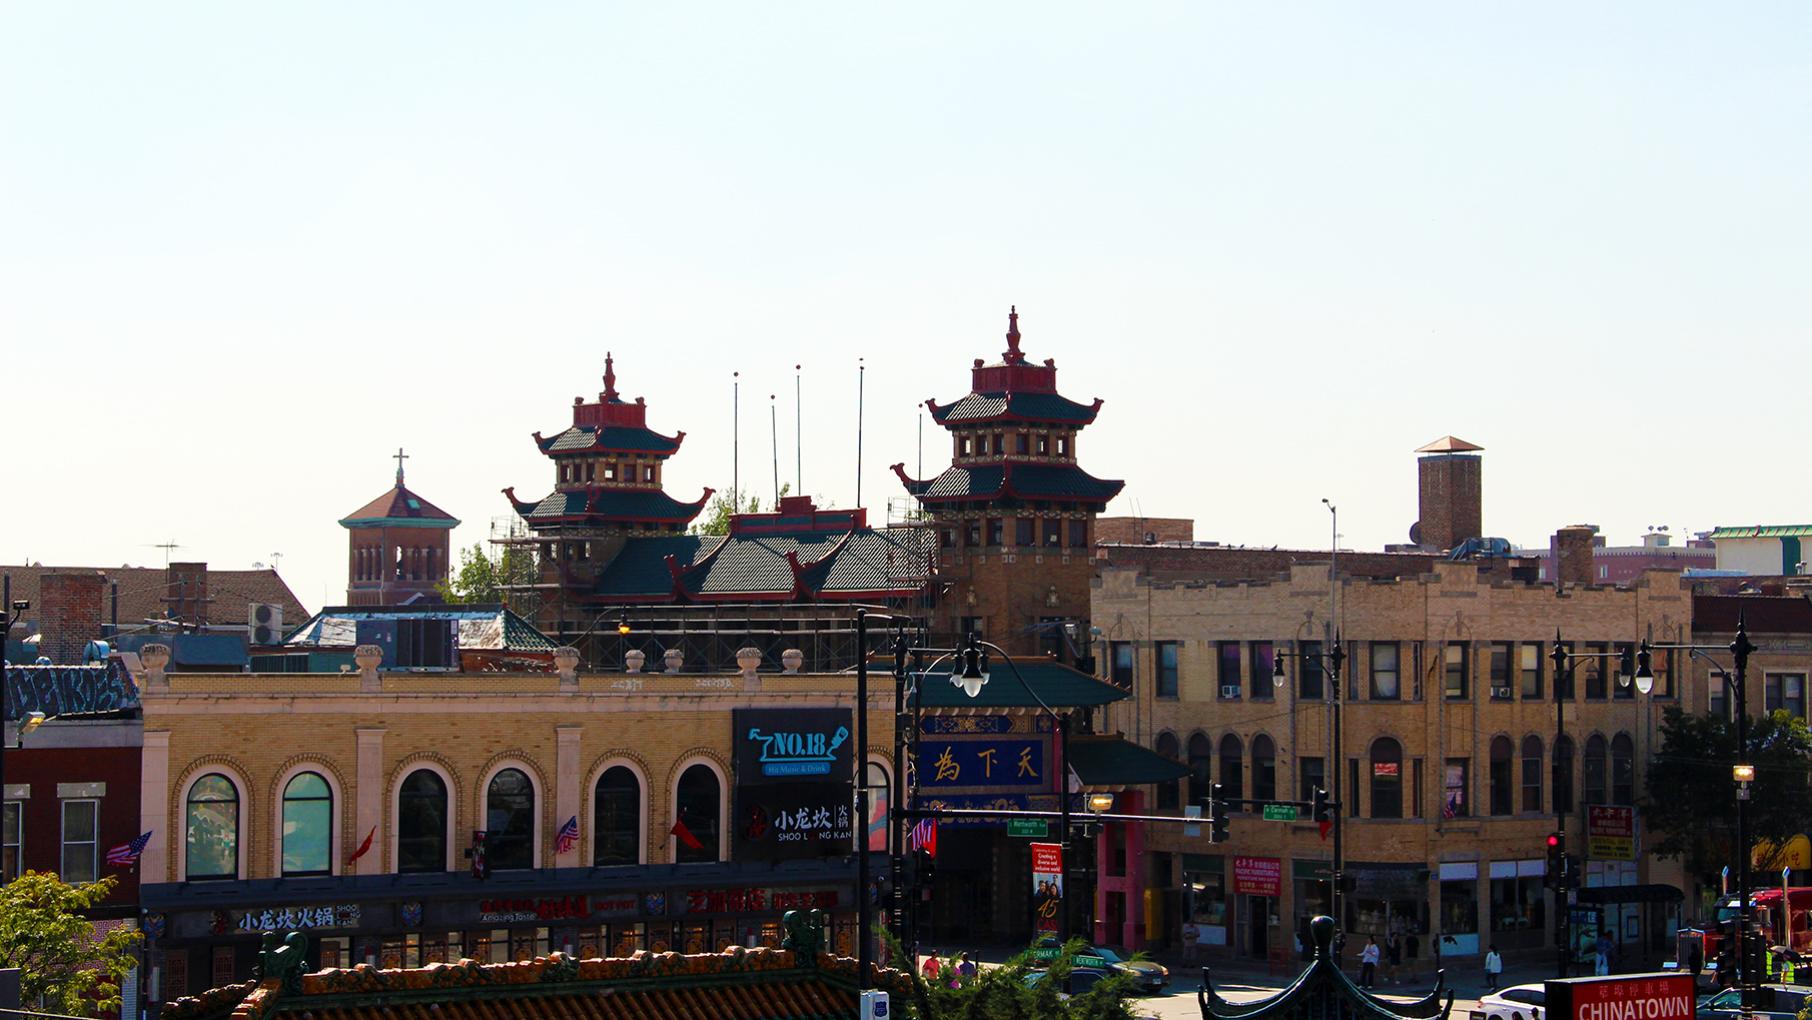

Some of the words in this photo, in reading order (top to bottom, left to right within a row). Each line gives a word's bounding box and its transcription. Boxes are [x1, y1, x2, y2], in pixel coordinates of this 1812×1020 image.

[773, 732, 826, 756] NO.18
[774, 806, 833, 831] 小龙坎
[778, 832, 802, 842] SHOO
[834, 831, 852, 840] KAN
[239, 907, 334, 932] 小龙坎火锅
[1579, 995, 1689, 1020] CHINATOWN
